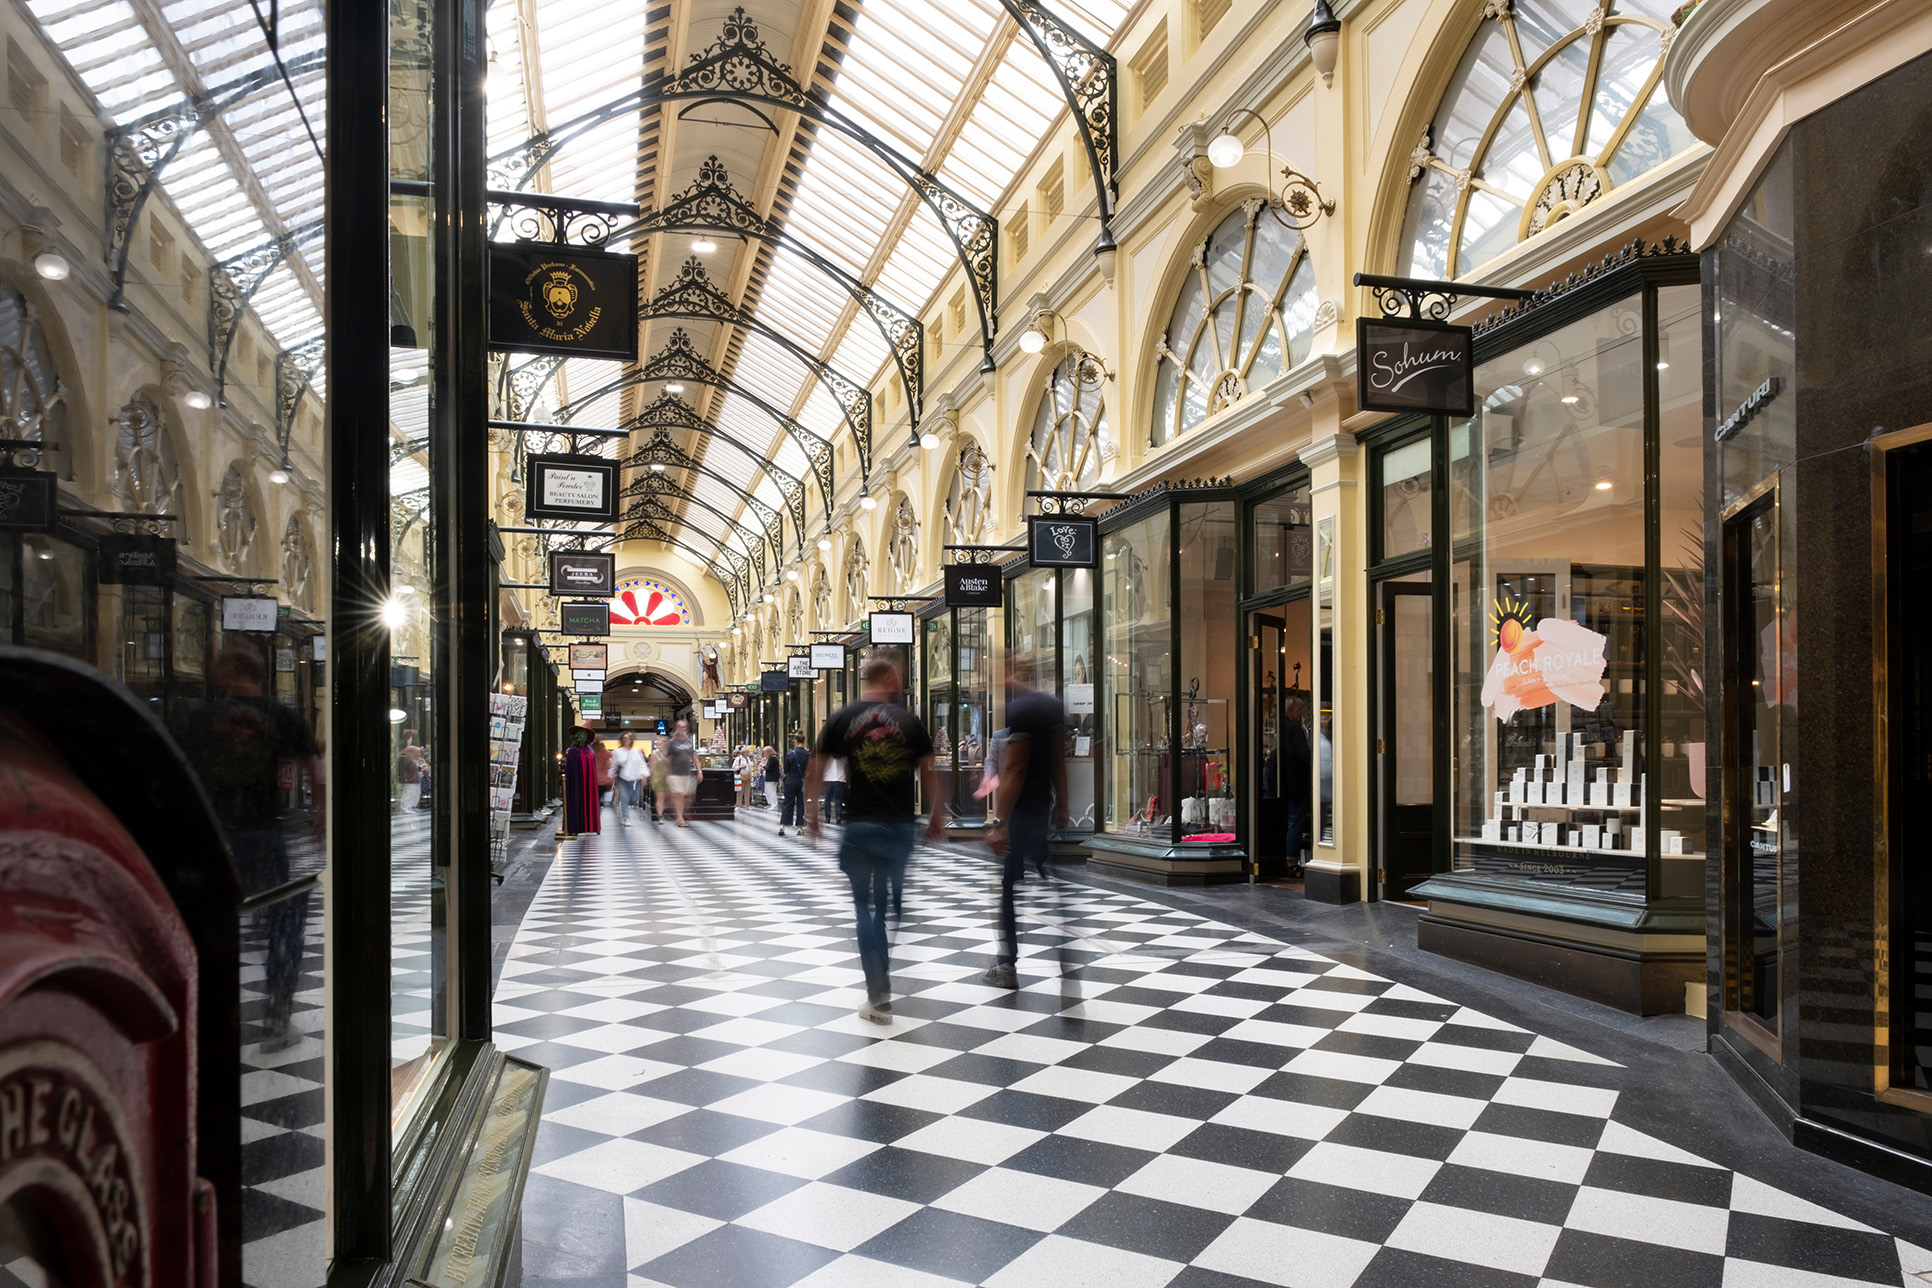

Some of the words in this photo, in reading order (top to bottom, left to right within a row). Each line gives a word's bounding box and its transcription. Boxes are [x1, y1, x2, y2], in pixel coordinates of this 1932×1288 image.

[538, 327, 574, 341] Maria
[573, 306, 602, 341] Novella
[1370, 341, 1462, 389] Sohum
[1714, 377, 1773, 442] CANTURI
[556, 481, 582, 490] Powder
[959, 578, 988, 586] Austen
[959, 583, 988, 592] &Blake
[1495, 659, 1538, 679] PEACH
[1543, 648, 1601, 671] ROYALE
[1496, 846, 1519, 854] MADE
[1534, 849, 1591, 860] MELBOURNE
[1543, 864, 1565, 875] 2003
[0, 1079, 52, 1161] HE
[449, 1206, 484, 1267] CREATIVE
